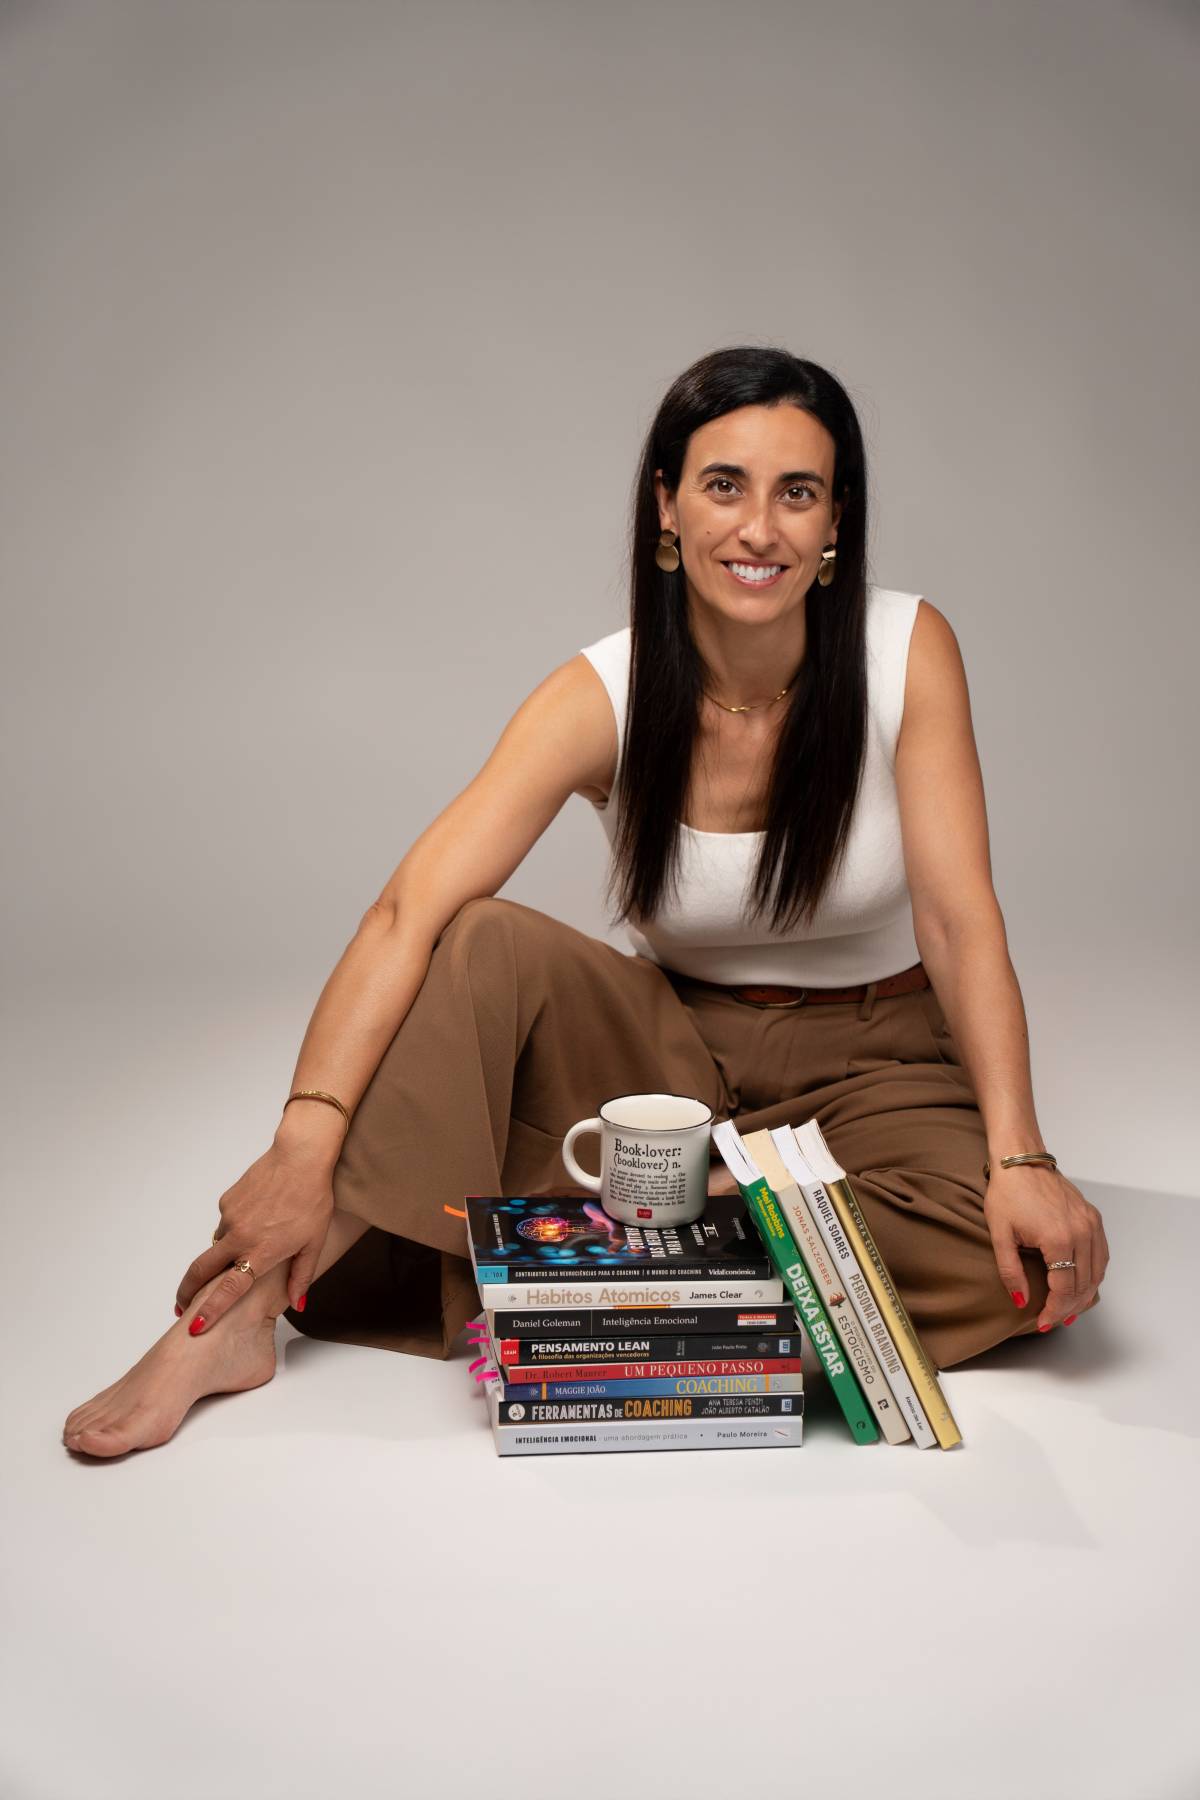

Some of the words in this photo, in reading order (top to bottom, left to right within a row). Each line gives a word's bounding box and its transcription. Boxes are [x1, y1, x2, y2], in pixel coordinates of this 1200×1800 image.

[614, 1152, 668, 1172] (booklover)
[760, 1186, 770, 1204] Mel
[767, 1203, 785, 1239] Robbins
[812, 1189, 834, 1226] RAQUEL
[828, 1224, 850, 1260] SOARES
[792, 1206, 810, 1234] JONAS
[806, 1236, 832, 1286] SALZGEBER
[854, 1211, 866, 1237] CURA
[876, 1265, 896, 1302] DENTRO
[526, 1288, 592, 1304] Hábitos
[598, 1288, 680, 1303] Atómicos
[690, 1292, 717, 1300] James
[720, 1290, 743, 1299] Clear
[512, 1318, 540, 1328] Daniel
[542, 1318, 581, 1328] Goleman
[602, 1317, 651, 1328] Inteligência
[654, 1316, 698, 1325] Emocional
[786, 1263, 819, 1322] DEIXA
[811, 1320, 845, 1378] ESTAR
[850, 1274, 879, 1324] PERSONAL
[871, 1322, 901, 1374] BRANDING
[532, 1343, 614, 1353] PENSAMENTO
[618, 1341, 650, 1351] LEAN
[838, 1316, 874, 1384] ESTOICISMO
[576, 1352, 615, 1360] organizações
[524, 1372, 538, 1380] Dr.
[543, 1370, 572, 1378] Robert
[576, 1370, 608, 1378] Maurer
[624, 1366, 644, 1376] UM
[650, 1364, 716, 1376] PEQUENO
[721, 1362, 764, 1374] PASSO
[555, 1386, 586, 1395] MAGGIE
[586, 1385, 606, 1394] JOÃO
[676, 1378, 758, 1394] COACHING
[532, 1404, 613, 1420] FERRAMENTAS
[614, 1408, 624, 1418] DE
[624, 1398, 692, 1418] COACHING
[722, 1398, 743, 1406] TERESA
[701, 1406, 716, 1415] JOÃO
[744, 1406, 770, 1414] CATALÃO
[516, 1436, 559, 1444] INTELIGÊNCIA
[621, 1434, 661, 1442] abordagem
[663, 1433, 688, 1442] prática
